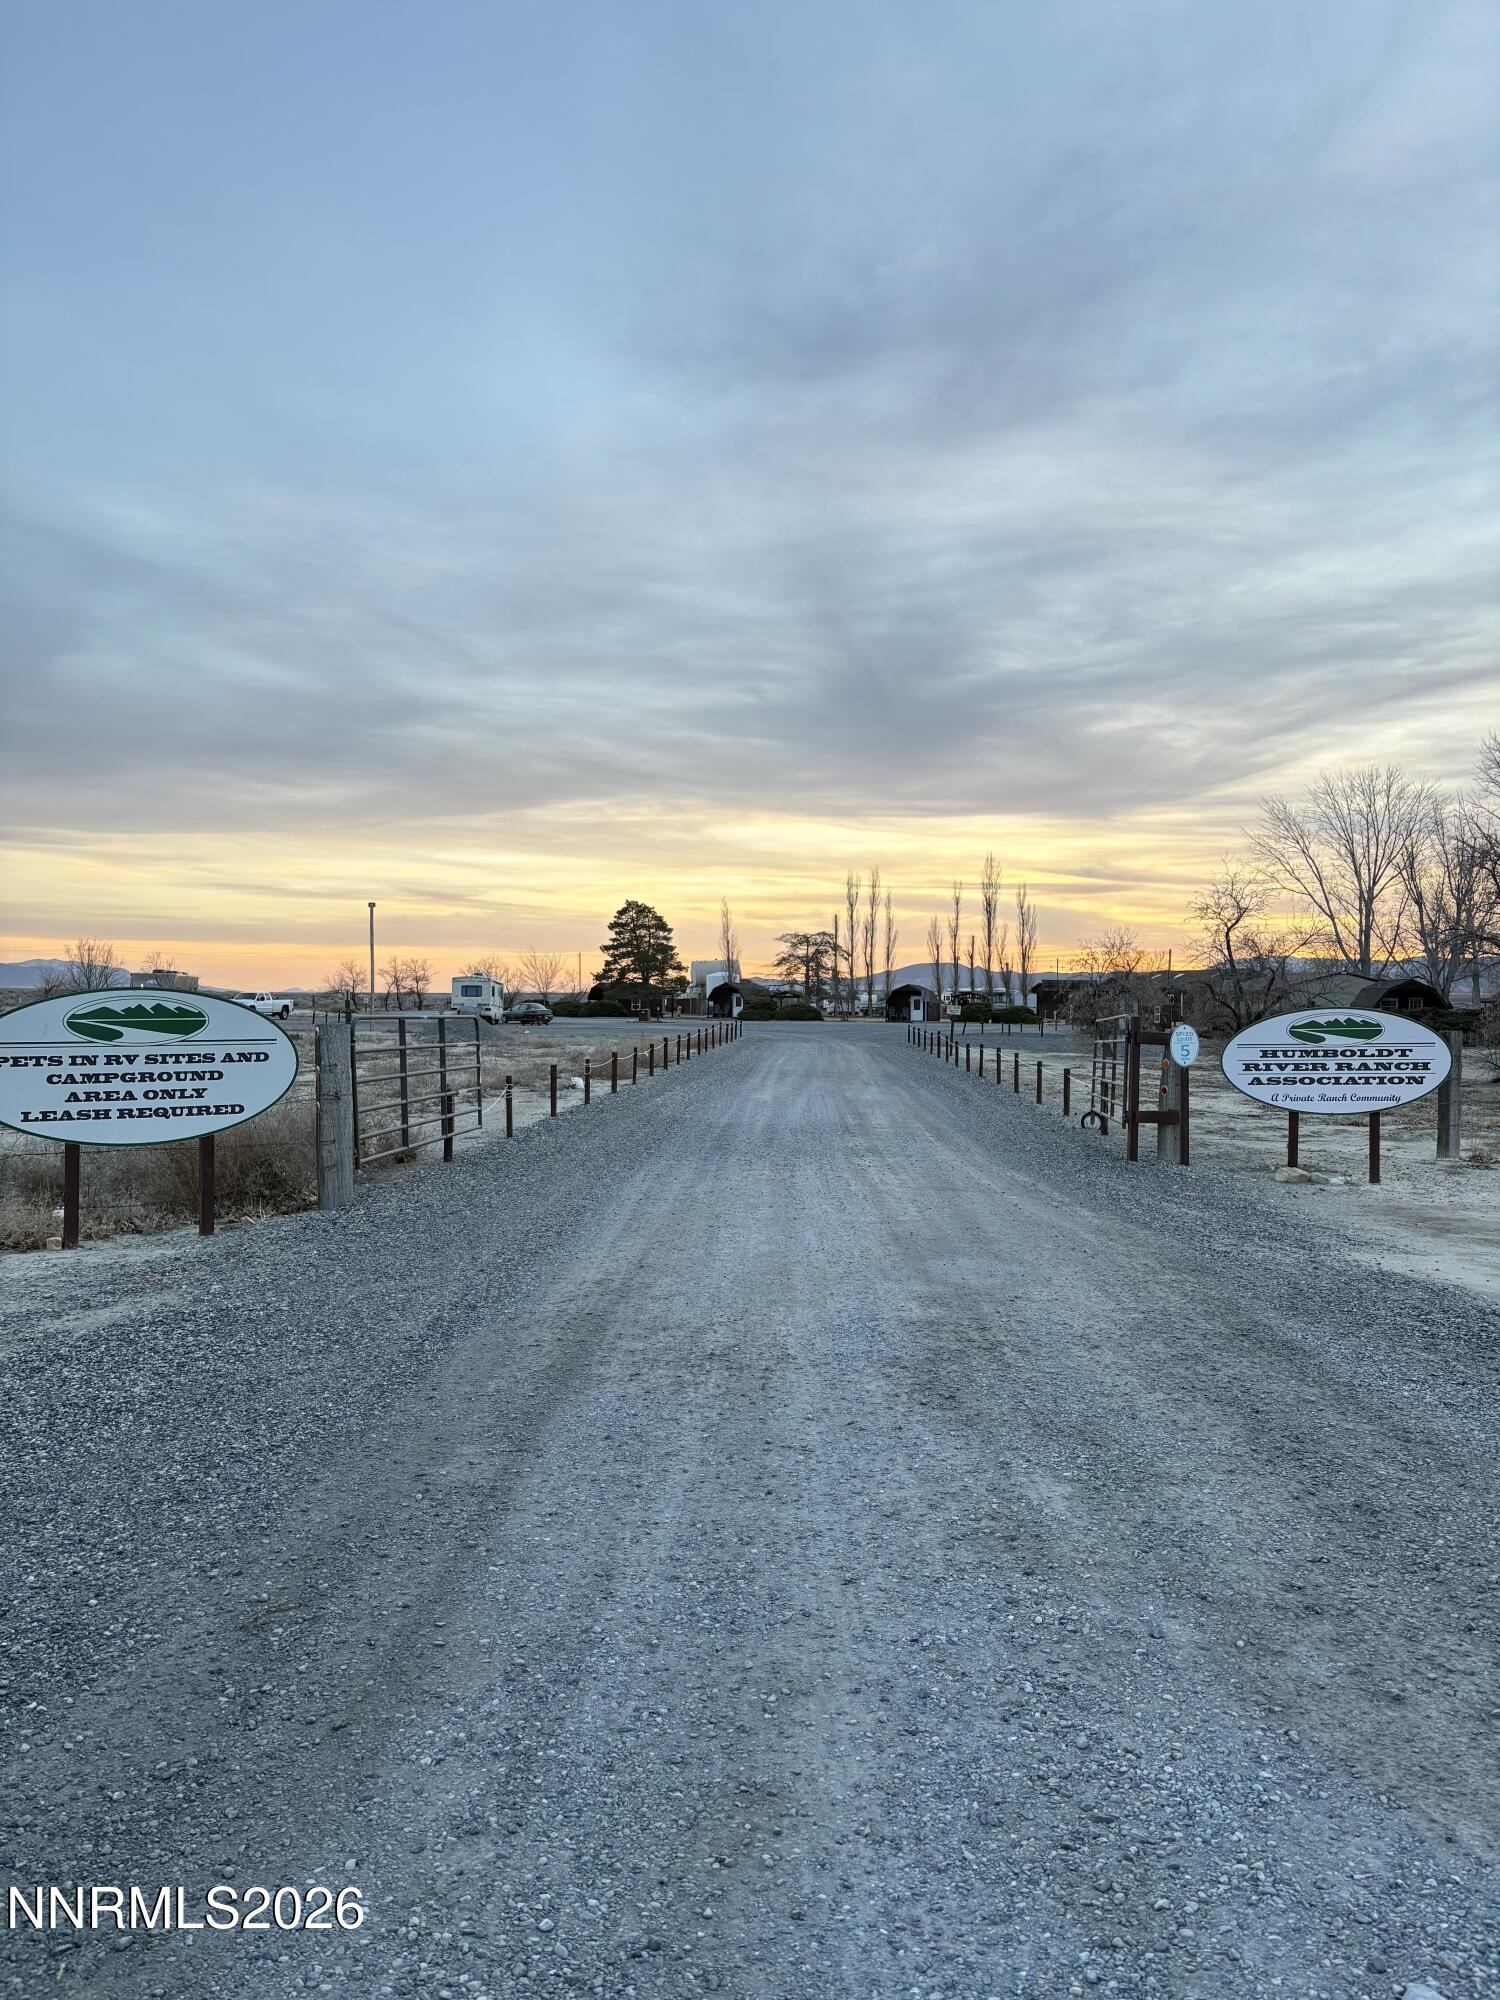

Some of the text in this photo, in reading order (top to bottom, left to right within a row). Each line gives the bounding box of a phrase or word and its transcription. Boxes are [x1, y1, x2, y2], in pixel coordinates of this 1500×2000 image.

[1181, 1045, 1190, 1057] 5
[1259, 1049, 1413, 1058] HUMBOLDT
[68, 1055, 99, 1066] IN
[104, 1055, 140, 1065] RV
[144, 1053, 216, 1064] SITES
[220, 1052, 270, 1063] AND
[1242, 1062, 1431, 1071] RIVER RANCH
[46, 1070, 224, 1084] CAMPGROUND
[1248, 1076, 1426, 1085] ASSOCIATION
[64, 1088, 208, 1102] AREA ONLY
[1271, 1093, 1401, 1103] A Private Ranch Community
[21, 1104, 245, 1122] LEASH REQUIRED
